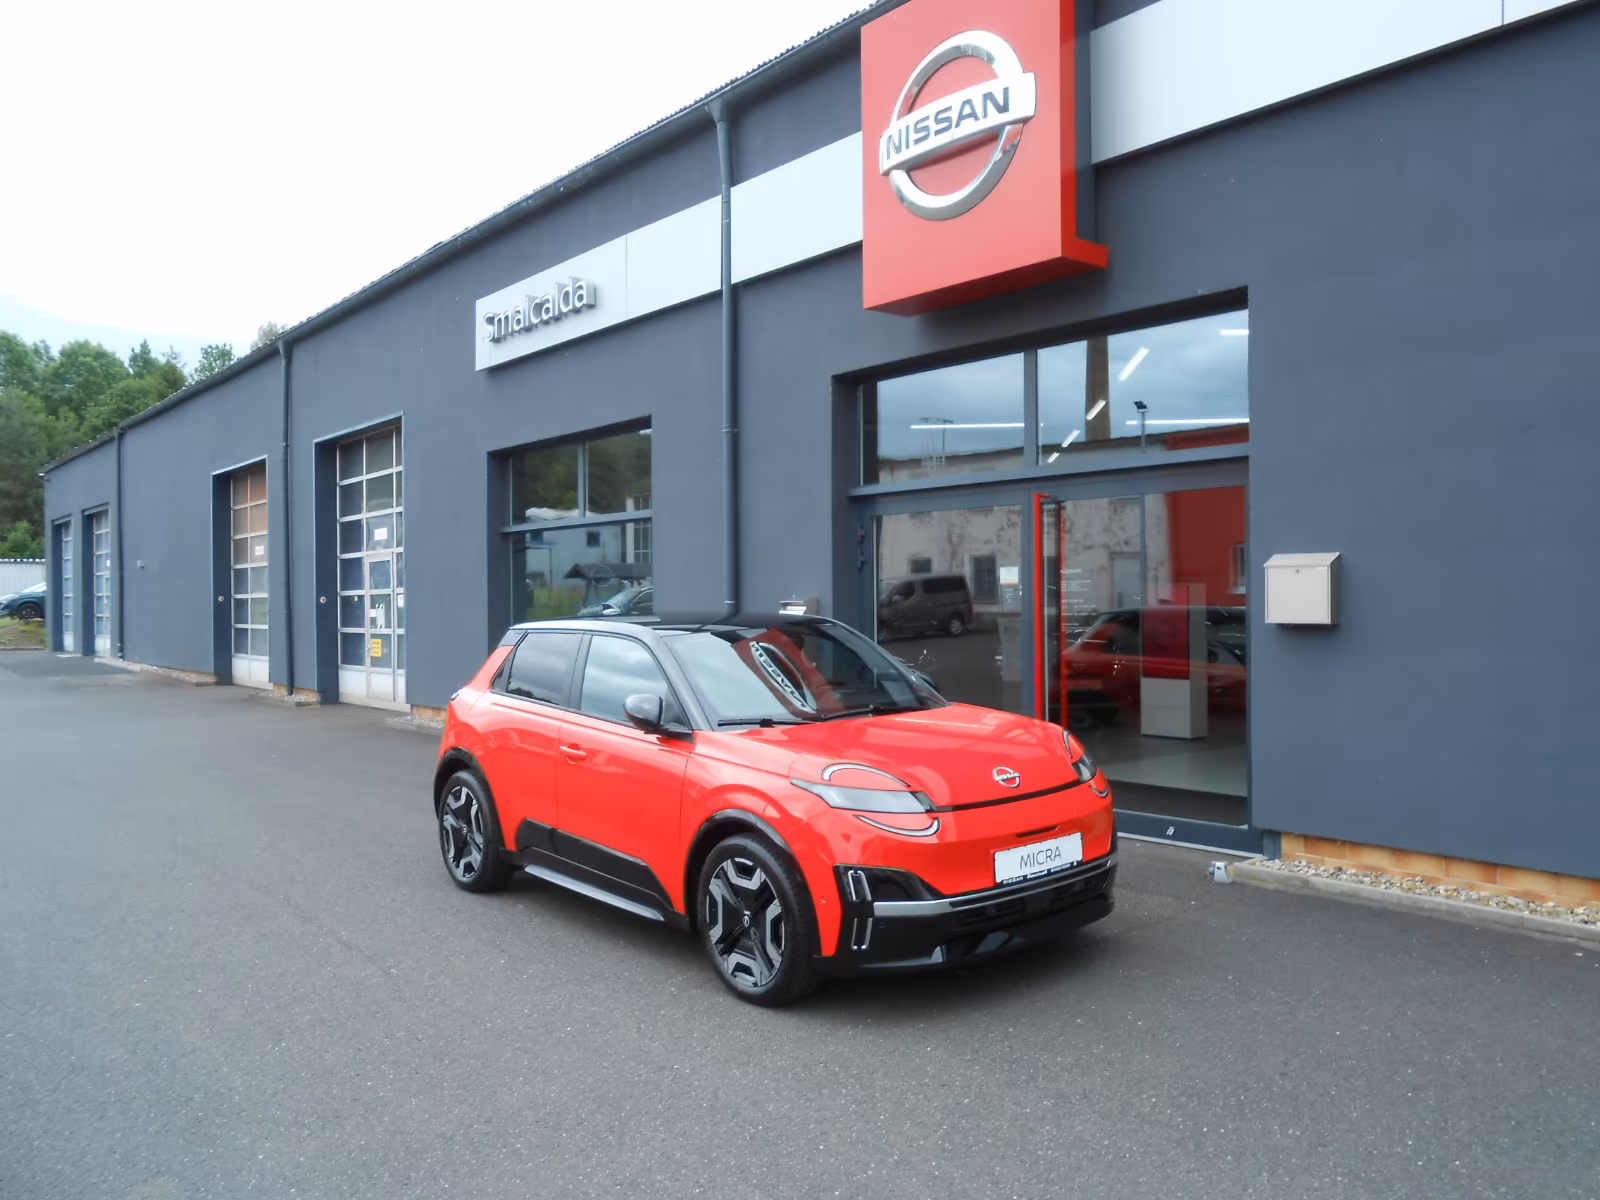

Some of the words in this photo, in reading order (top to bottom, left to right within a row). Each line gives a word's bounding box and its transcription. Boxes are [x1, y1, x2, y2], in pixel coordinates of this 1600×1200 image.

[886, 86, 1010, 161] NISSAN
[483, 276, 596, 342] Smalcalda
[1020, 846, 1062, 870] MICRA
